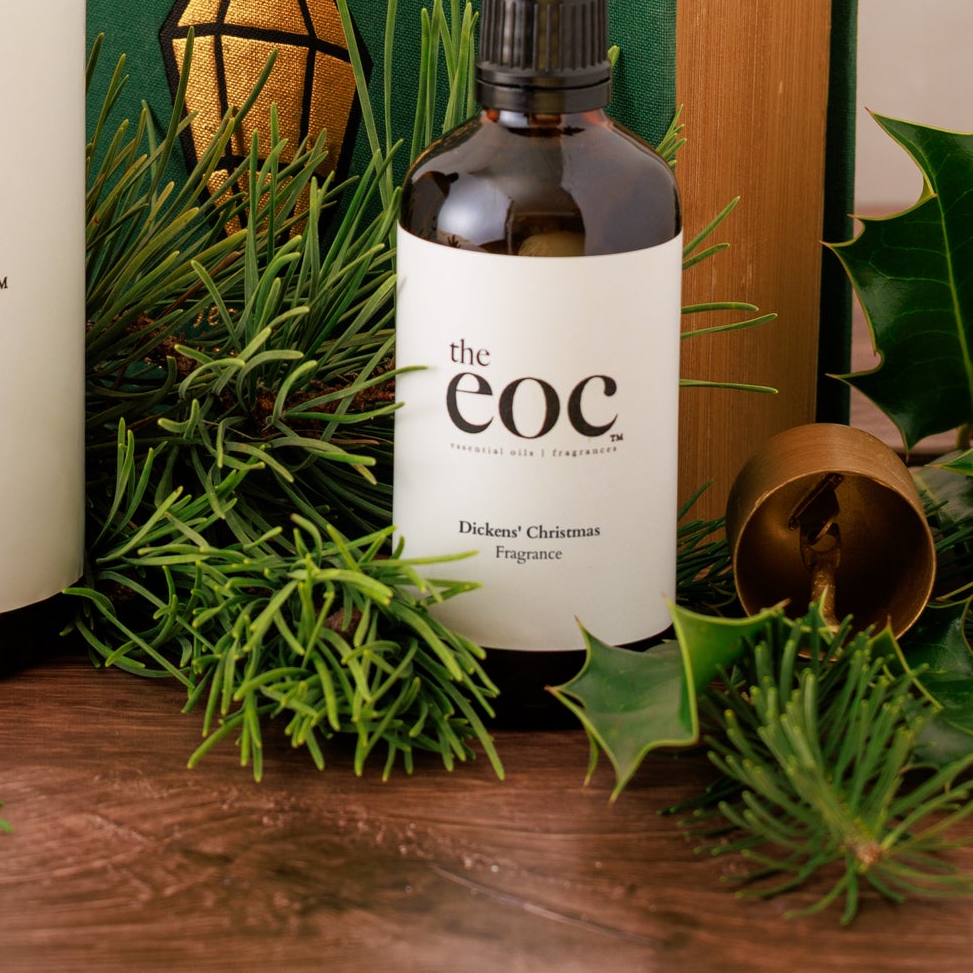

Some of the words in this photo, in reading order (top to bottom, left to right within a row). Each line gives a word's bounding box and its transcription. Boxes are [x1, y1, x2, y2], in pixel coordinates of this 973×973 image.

[449, 338, 491, 367] the
[445, 371, 619, 440] eoc
[450, 442, 504, 457] essential
[509, 448, 535, 458] oils
[551, 443, 618, 459] fragrances
[458, 520, 523, 540] Dickens'
[526, 523, 602, 540] Christmas
[494, 545, 564, 566] Fragrance
